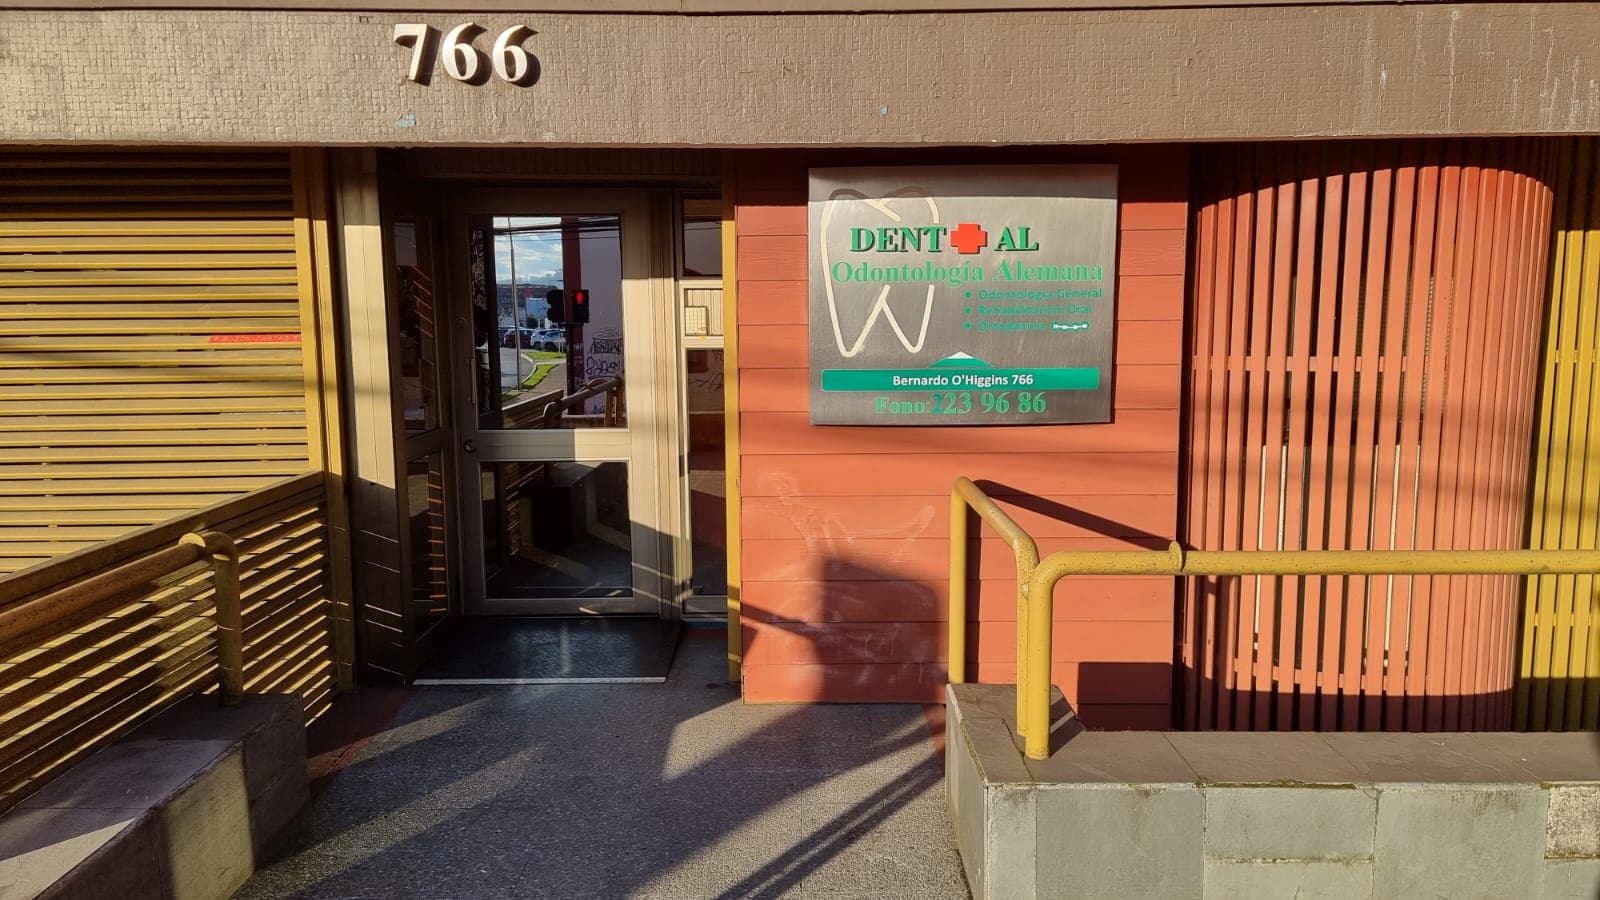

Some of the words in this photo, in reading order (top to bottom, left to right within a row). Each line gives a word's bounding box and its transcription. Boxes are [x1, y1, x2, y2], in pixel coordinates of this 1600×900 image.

[393, 22, 536, 84] 766
[850, 226, 946, 252] DENT
[993, 225, 1039, 252] AL
[832, 260, 984, 287] Odontología
[992, 259, 1103, 283] Alemana
[1056, 287, 1103, 299] General
[1066, 303, 1091, 315] Oral
[893, 375, 949, 386] Bernardo
[952, 375, 1008, 388] O'Higgins
[1011, 374, 1034, 385] 766
[875, 396, 930, 414] Fono:
[930, 393, 972, 414] 223
[980, 392, 1010, 413] 96
[1017, 391, 1047, 413] 86
